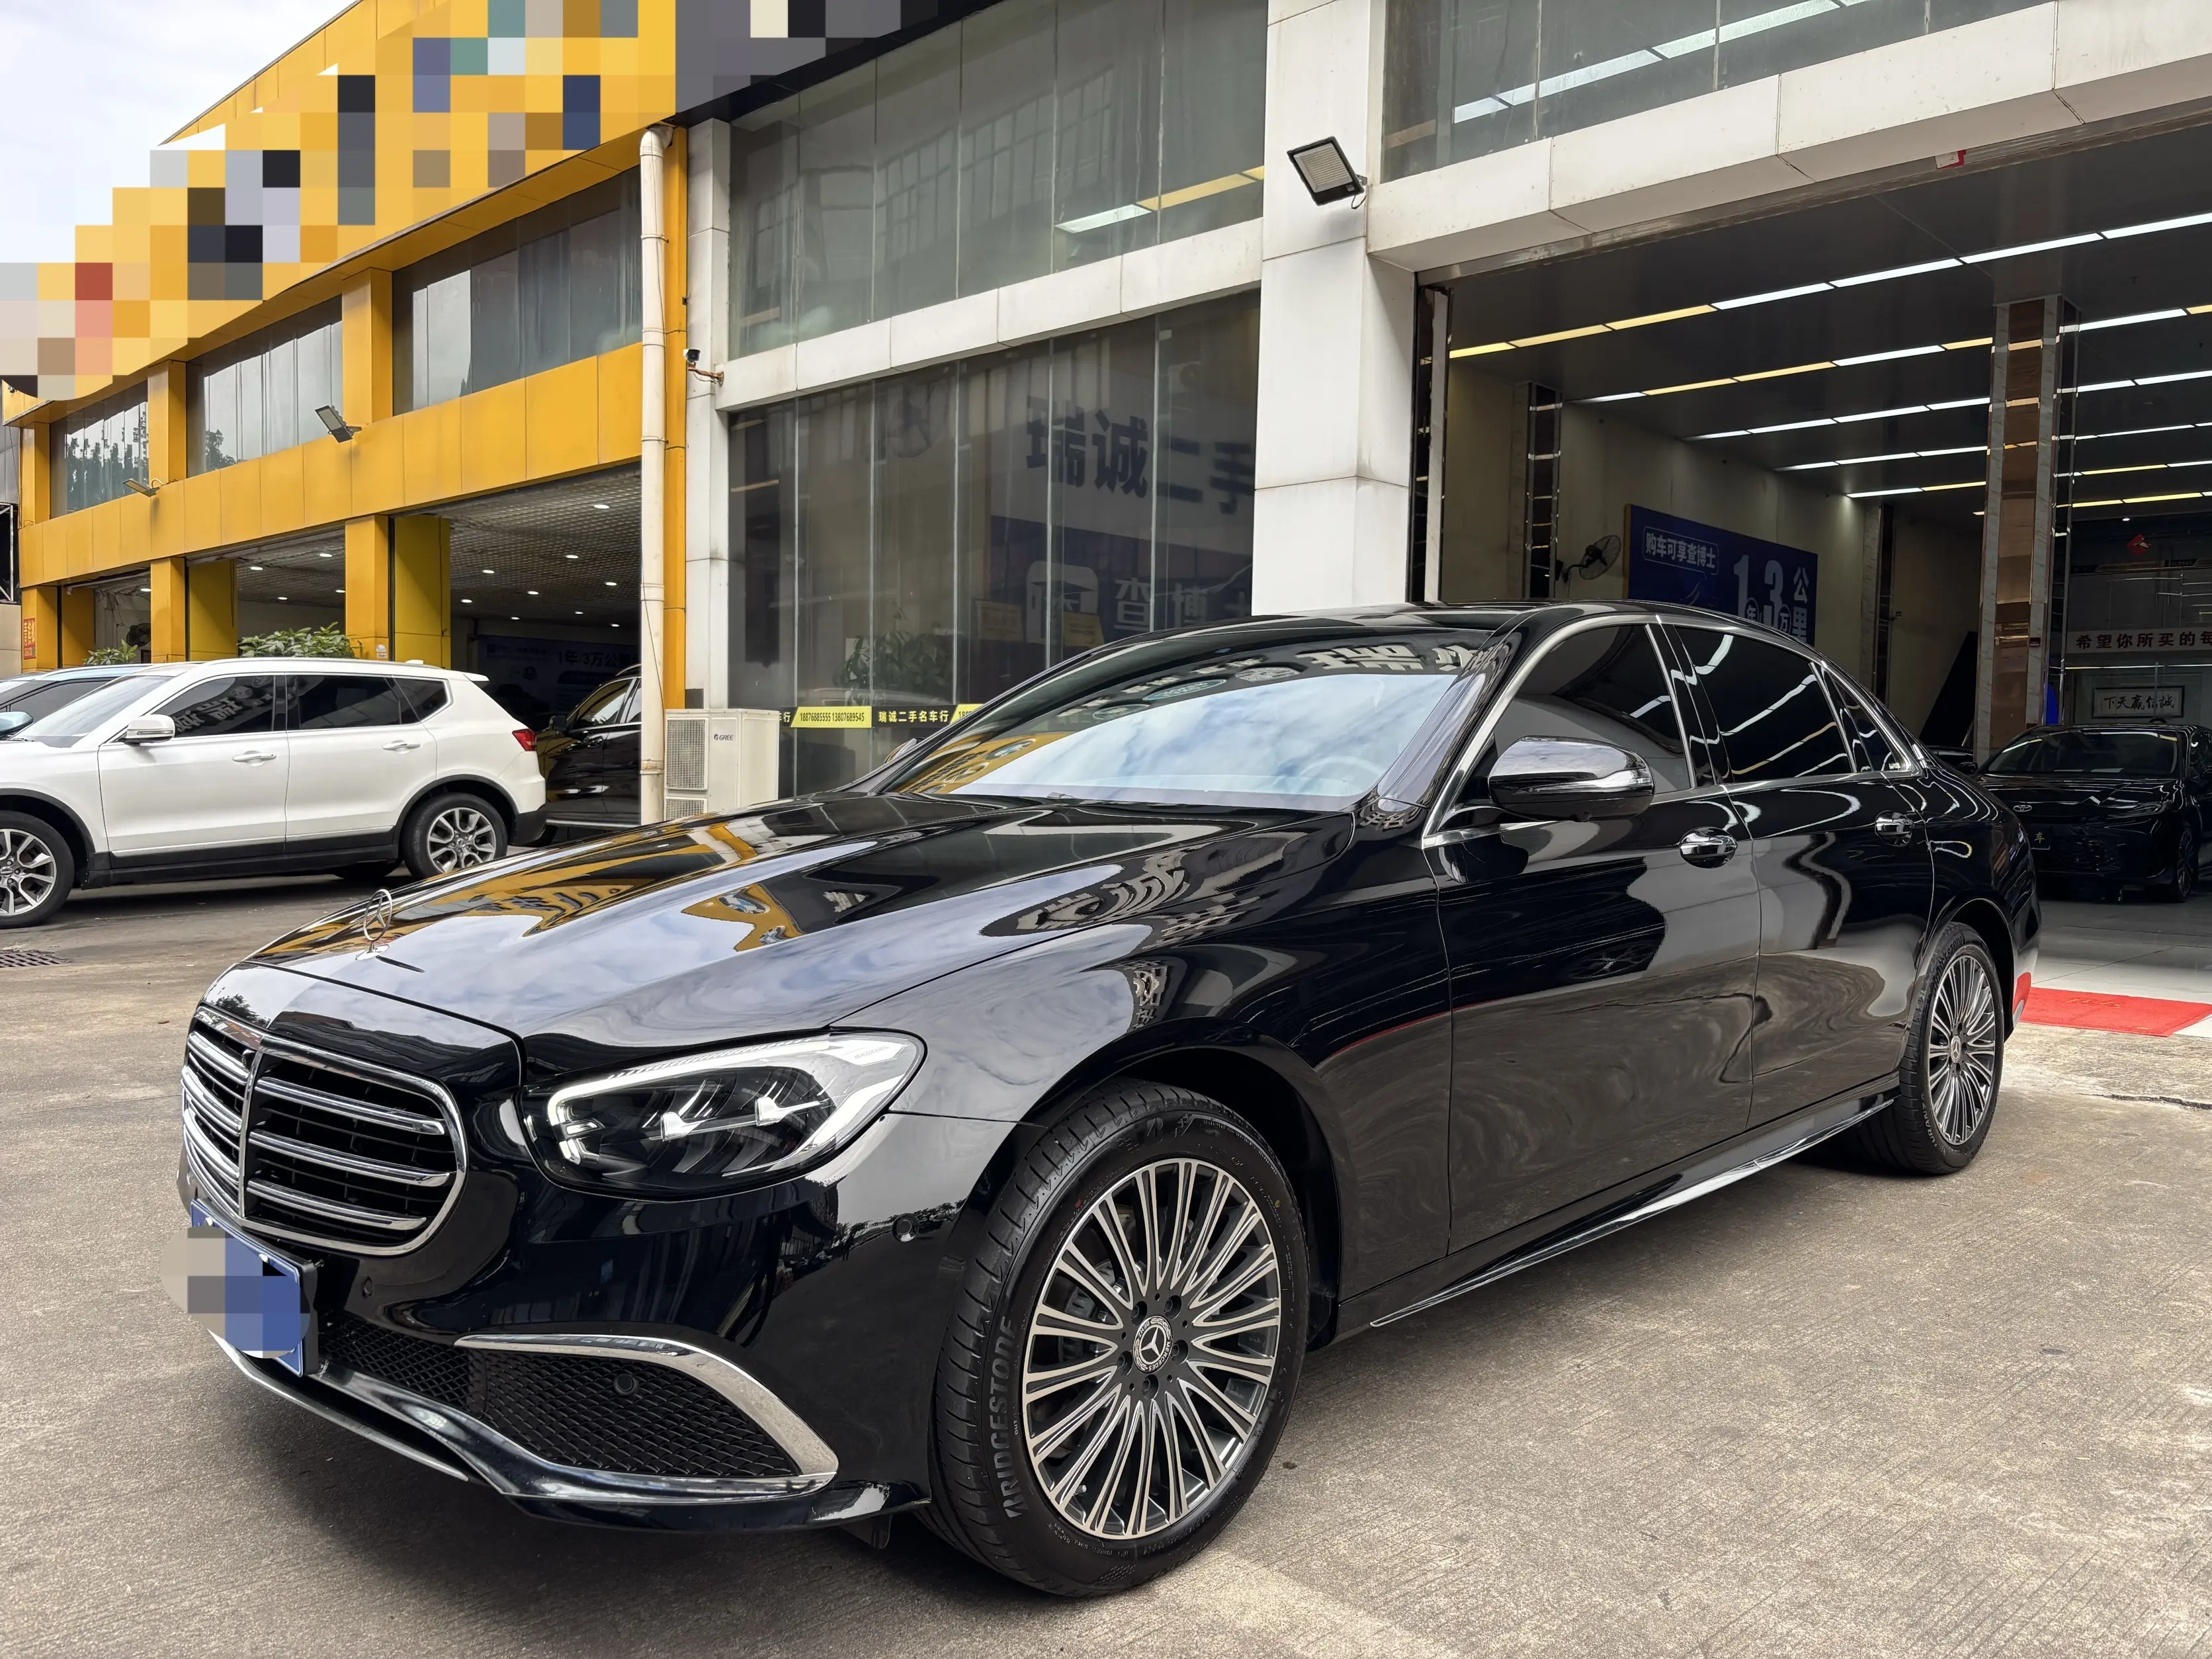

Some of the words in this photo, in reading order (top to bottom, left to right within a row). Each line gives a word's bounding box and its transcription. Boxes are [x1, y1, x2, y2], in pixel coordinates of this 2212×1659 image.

[1646, 532, 1717, 569] 购车可享查博士
[2076, 631, 2212, 650] 希望你所买的每
[800, 712, 831, 722] 18876885555
[832, 712, 865, 722] 13807689545
[878, 710, 949, 722] 瑞诚二手名车行
[1138, 1320, 1150, 1339] BENZ
[1148, 1341, 1171, 1372] MERCEDES
